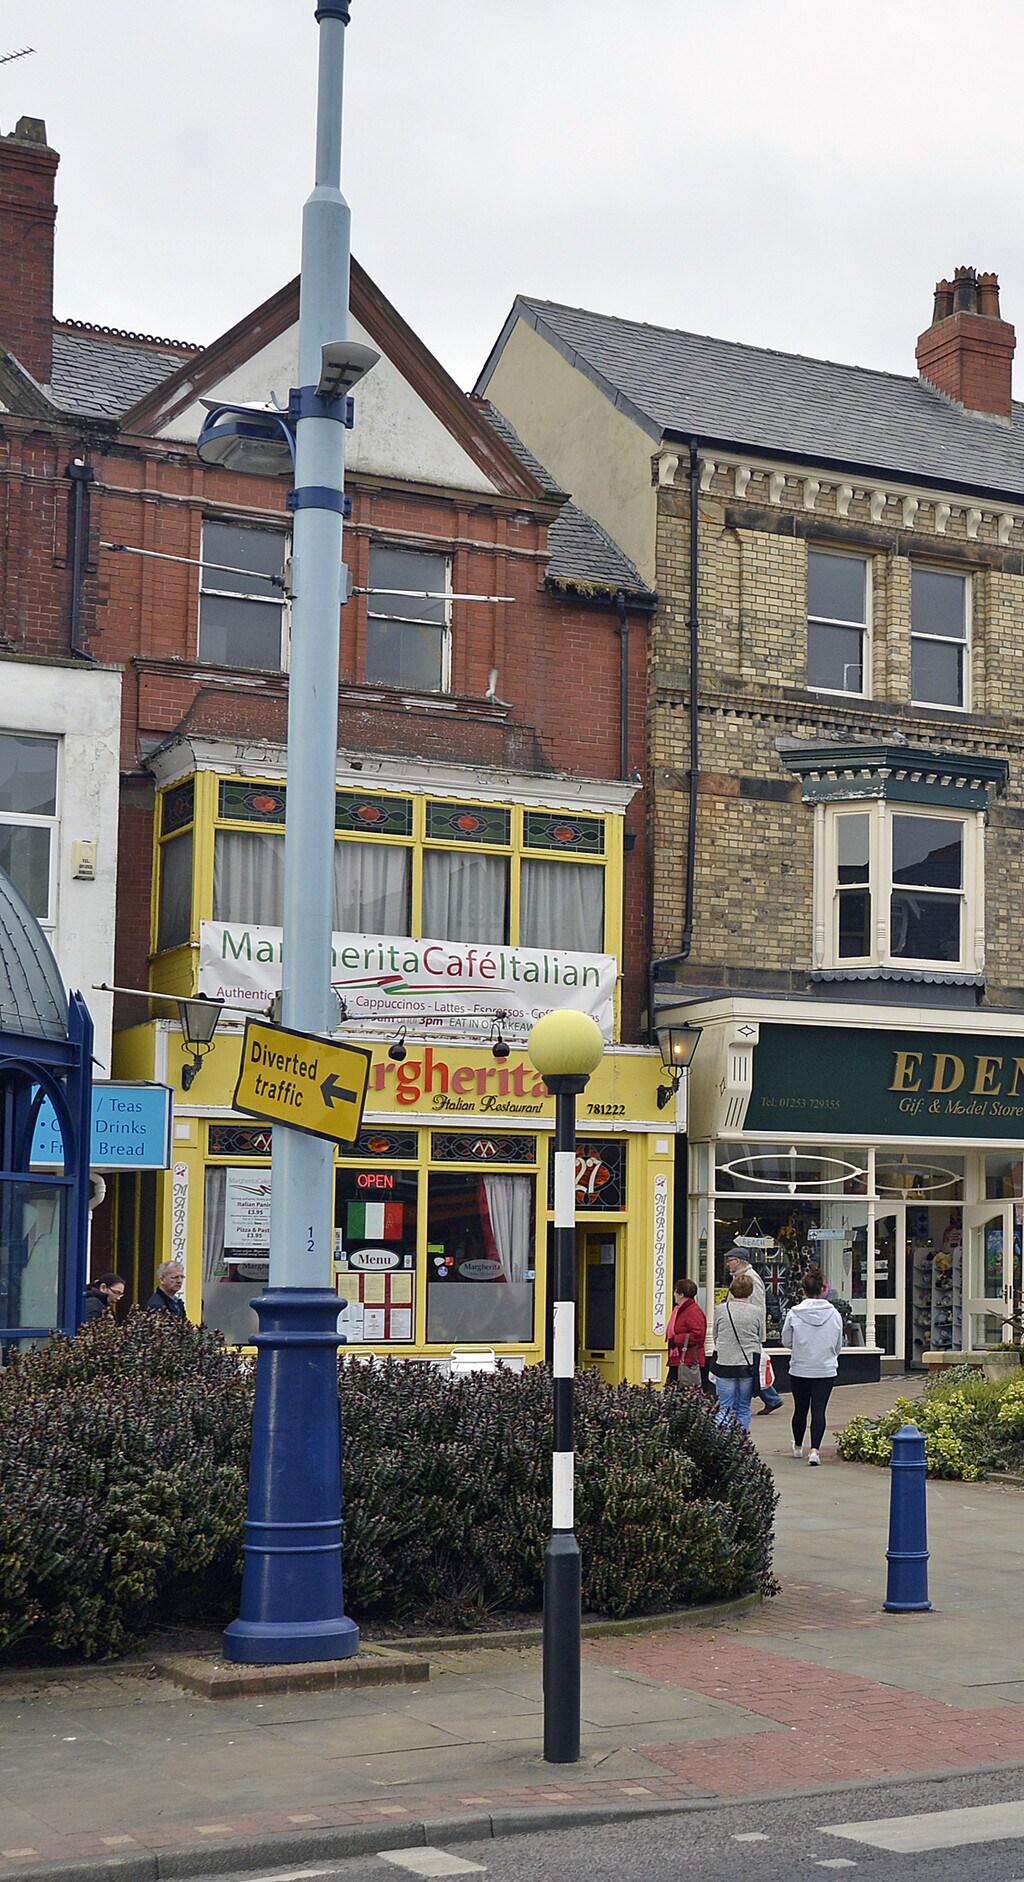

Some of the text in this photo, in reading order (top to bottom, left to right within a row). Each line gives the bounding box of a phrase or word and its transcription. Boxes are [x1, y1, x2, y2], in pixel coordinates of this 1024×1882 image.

[222, 930, 600, 987] MaeritaCaféItalian
[217, 986, 274, 1001] Authentic
[356, 996, 425, 1011] Cappuccinos
[434, 1001, 465, 1014] Lattes
[419, 1016, 443, 1027] 3pm
[450, 1018, 467, 1028] EAT
[469, 1019, 479, 1028] IN
[498, 1021, 533, 1032] TAKEAW
[251, 1041, 318, 1081] Diverted
[367, 1048, 555, 1105] rgherita
[255, 1074, 303, 1107] traffic
[109, 1098, 143, 1113] Teas
[432, 1094, 544, 1114] Italian Restaurant
[587, 1103, 626, 1116] 781222
[779, 1098, 806, 1108] 01253
[808, 1099, 840, 1110] 729355
[928, 1098, 941, 1113] &
[945, 1100, 988, 1116] Model
[989, 1101, 1024, 1117] Store
[95, 1119, 147, 1135] Drinks
[99, 1141, 145, 1156] Bread
[357, 1173, 394, 1189] OPEN
[575, 1157, 602, 1193] 27
[358, 1253, 392, 1265] Menu
[654, 1193, 667, 1316] MARGHERITA
[463, 1263, 501, 1272] Margherita
